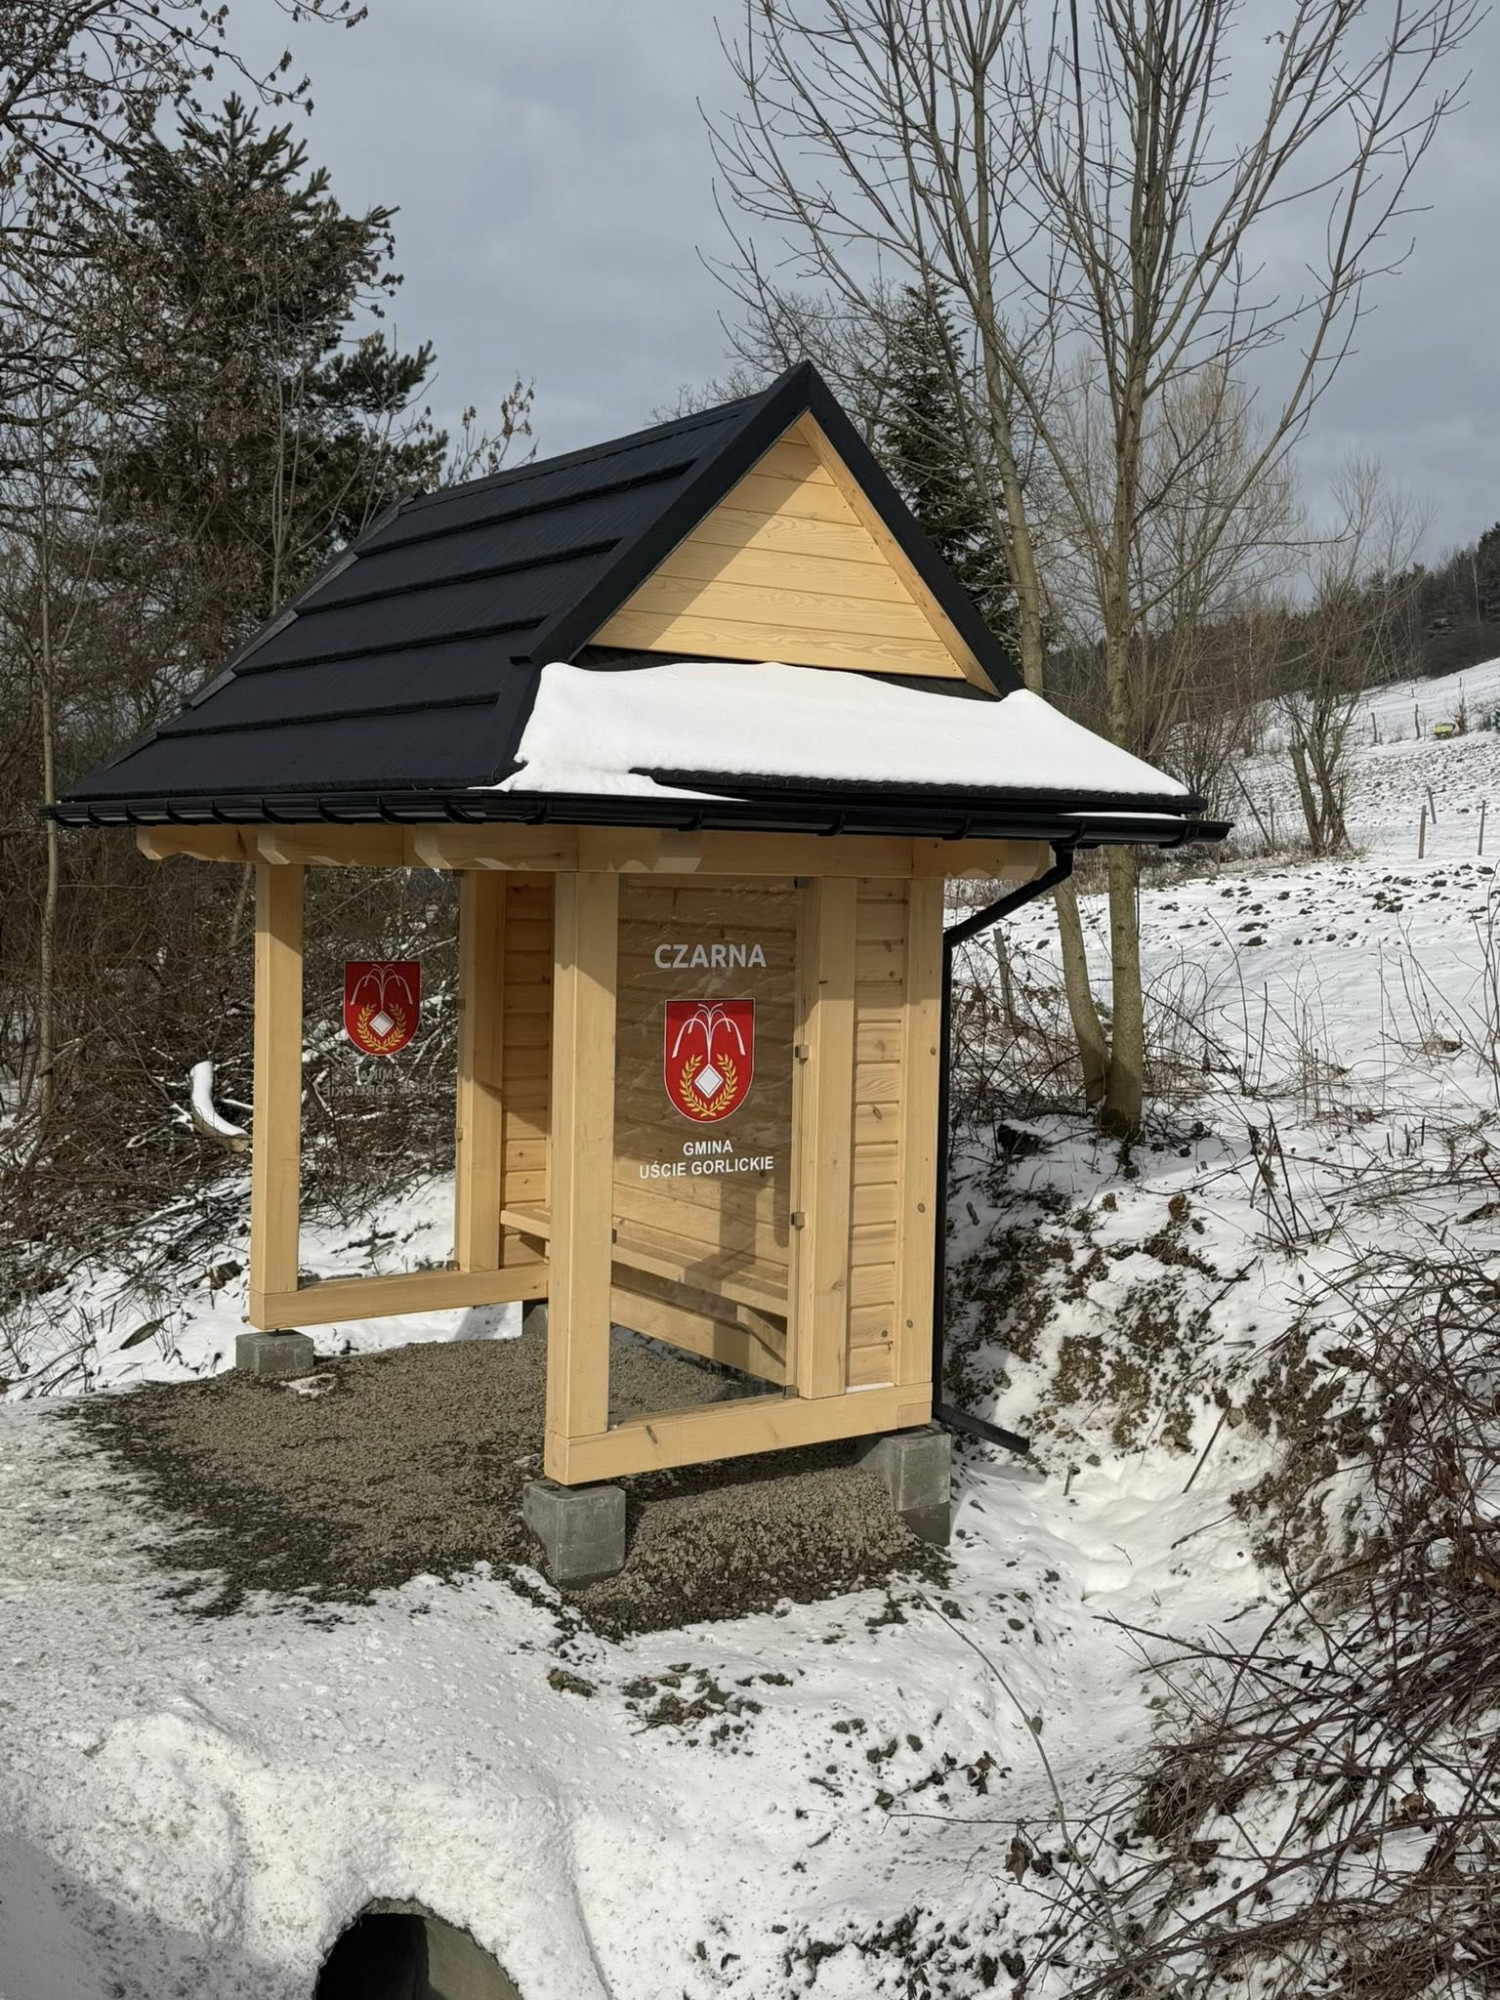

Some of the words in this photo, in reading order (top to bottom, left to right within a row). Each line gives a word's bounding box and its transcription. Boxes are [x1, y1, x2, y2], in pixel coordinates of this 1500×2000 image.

[654, 943, 767, 969] CZARNA
[683, 1139, 733, 1156] GMINA
[639, 1160, 686, 1179] UŚCIE
[691, 1156, 774, 1175] GORLICKIE
